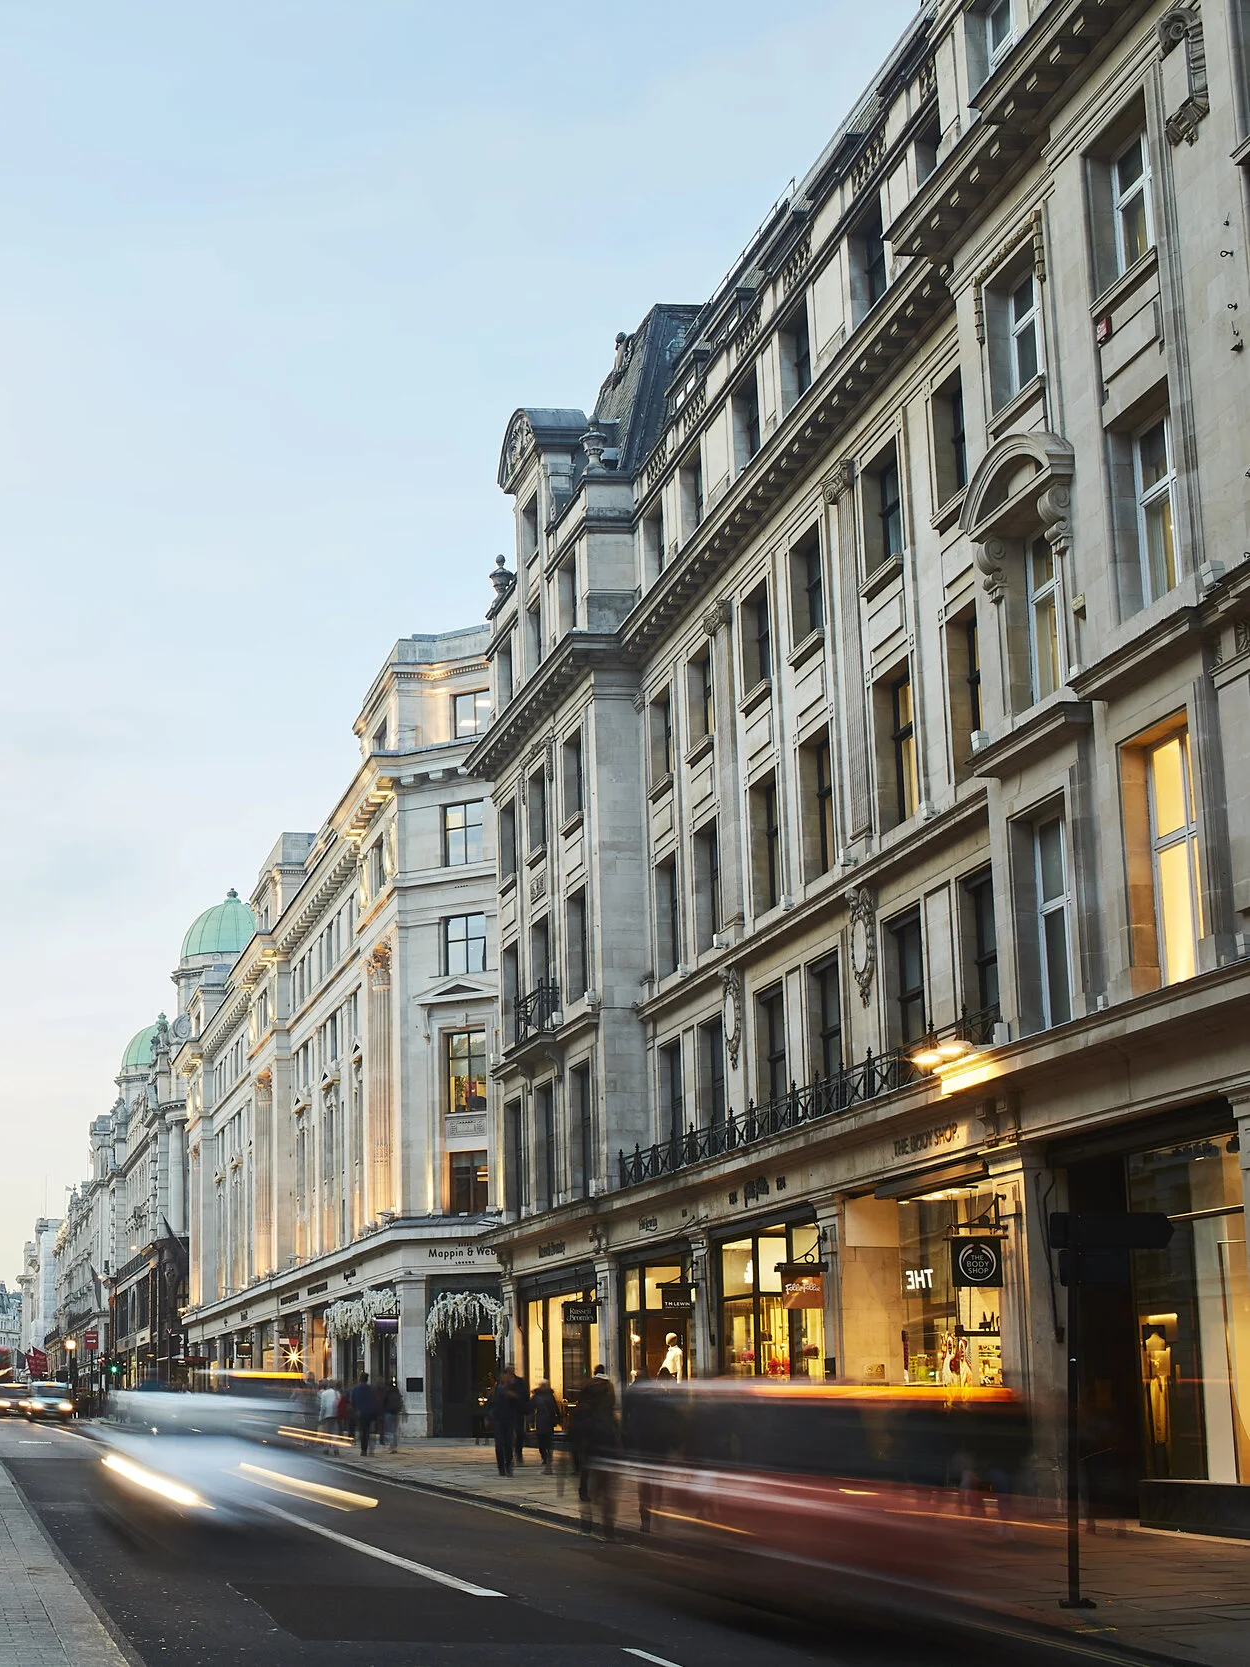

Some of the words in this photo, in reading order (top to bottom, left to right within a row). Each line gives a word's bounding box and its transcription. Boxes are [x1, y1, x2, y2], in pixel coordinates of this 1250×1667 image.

[428, 1247, 463, 1260] Mappin
[467, 1247, 474, 1256] &
[476, 1246, 497, 1256] Web
[966, 1260, 990, 1268] BODY
[967, 1267, 989, 1275] SHOP
